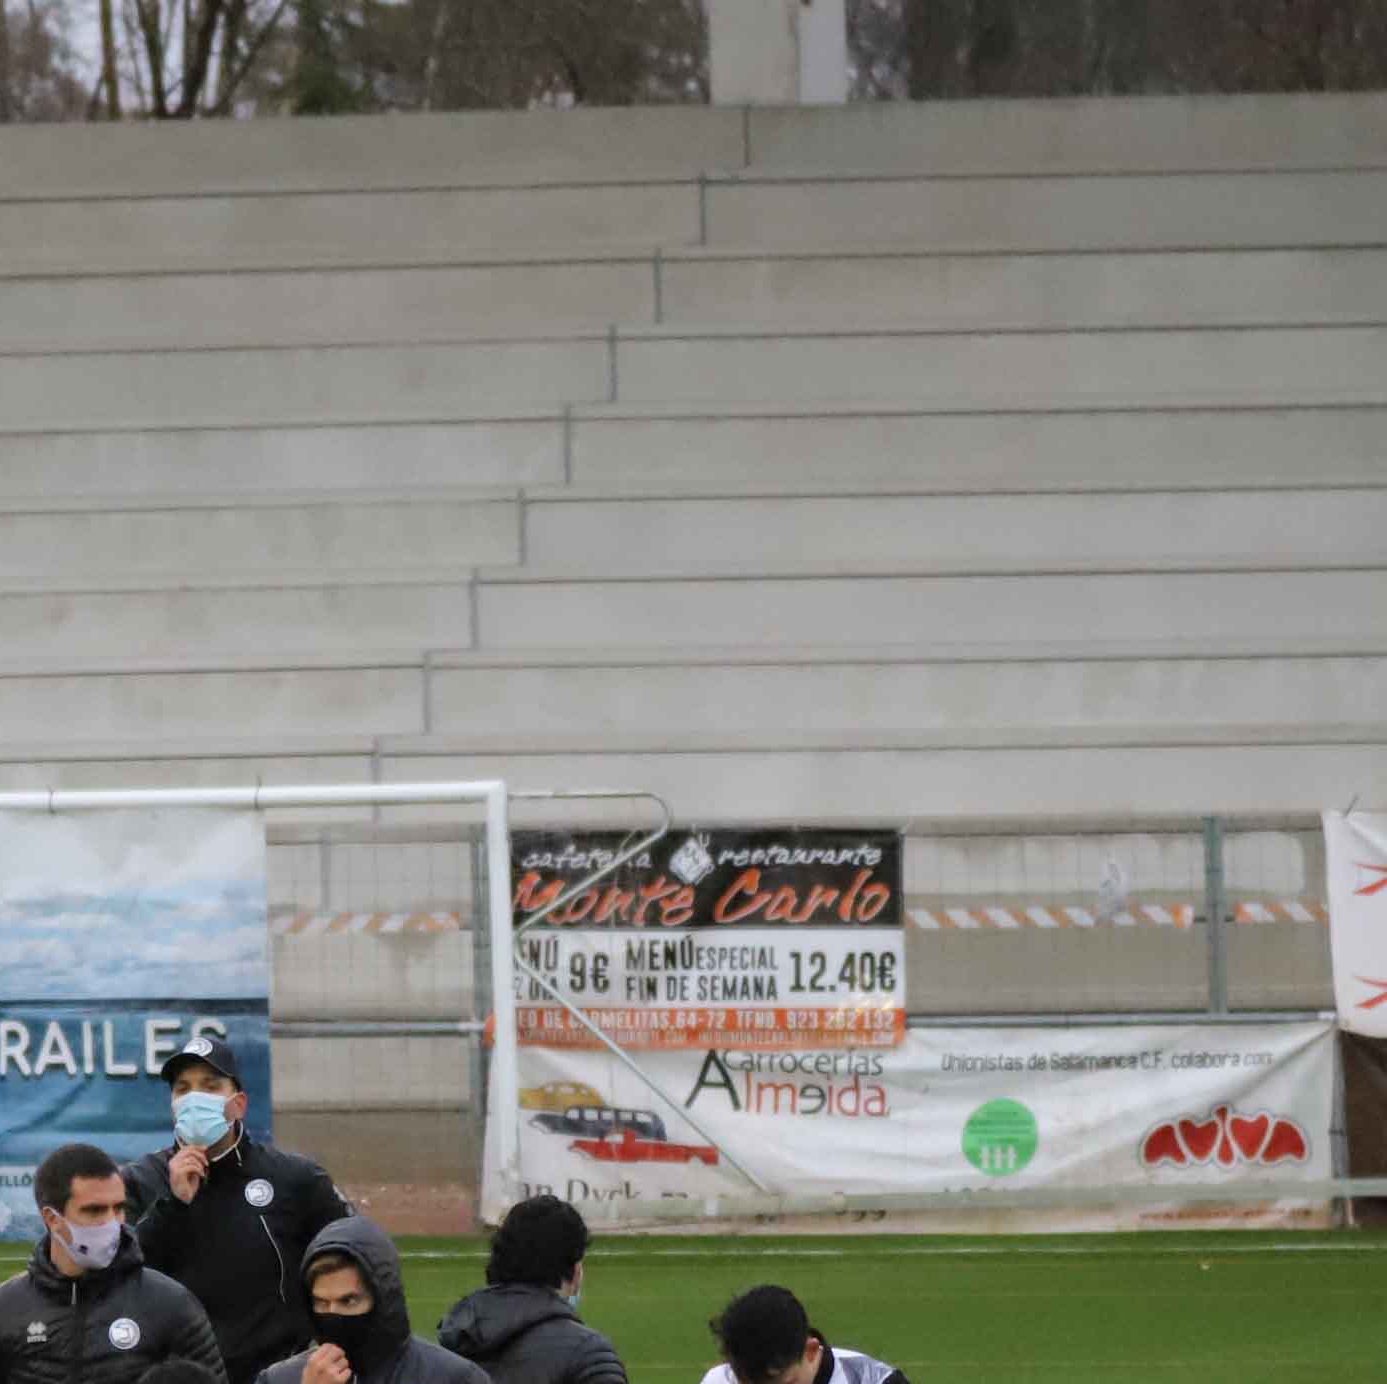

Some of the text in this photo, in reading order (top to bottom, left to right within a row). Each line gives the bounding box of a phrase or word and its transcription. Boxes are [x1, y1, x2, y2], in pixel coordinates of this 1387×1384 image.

[714, 868, 891, 923] Carlo
[626, 935, 693, 972] MENÚ
[789, 951, 897, 993] 12.40€
[627, 975, 779, 1001] FIN DE SEMANA
[941, 1053, 1025, 1073] Unionistas
[1027, 1053, 1047, 1071] de
